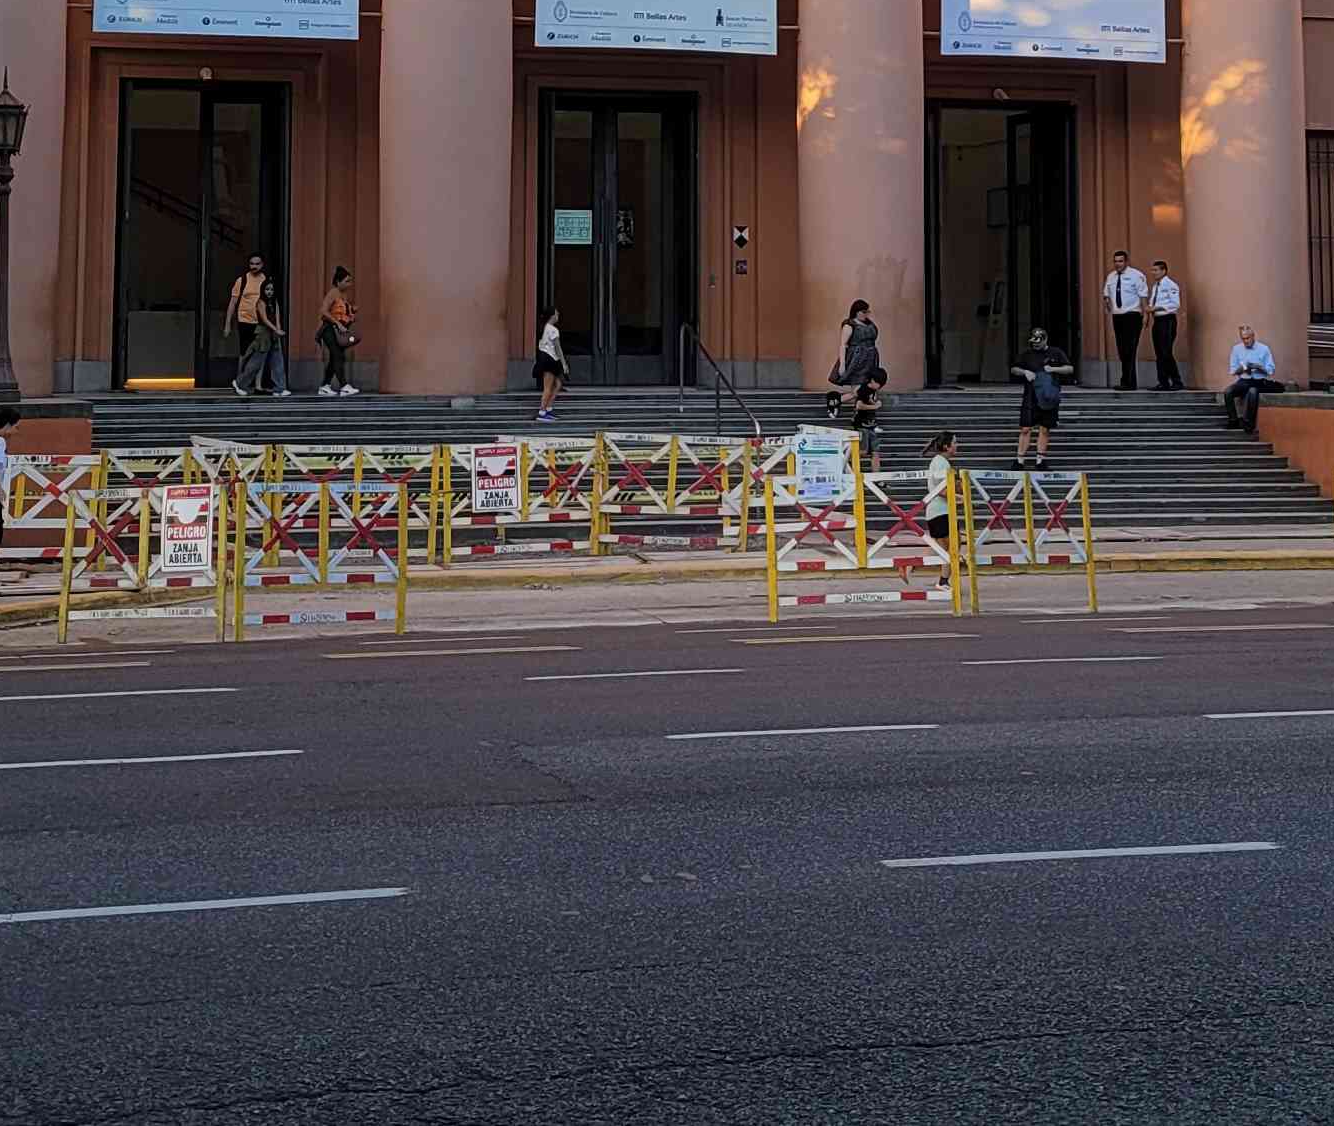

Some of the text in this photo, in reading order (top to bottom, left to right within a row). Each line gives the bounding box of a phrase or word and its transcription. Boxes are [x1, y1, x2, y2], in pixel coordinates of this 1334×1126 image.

[477, 477, 516, 488] PELIGRO
[167, 525, 207, 539] PELIGRO
[172, 543, 199, 553] ZANJA
[169, 554, 203, 564] ABIERTA
